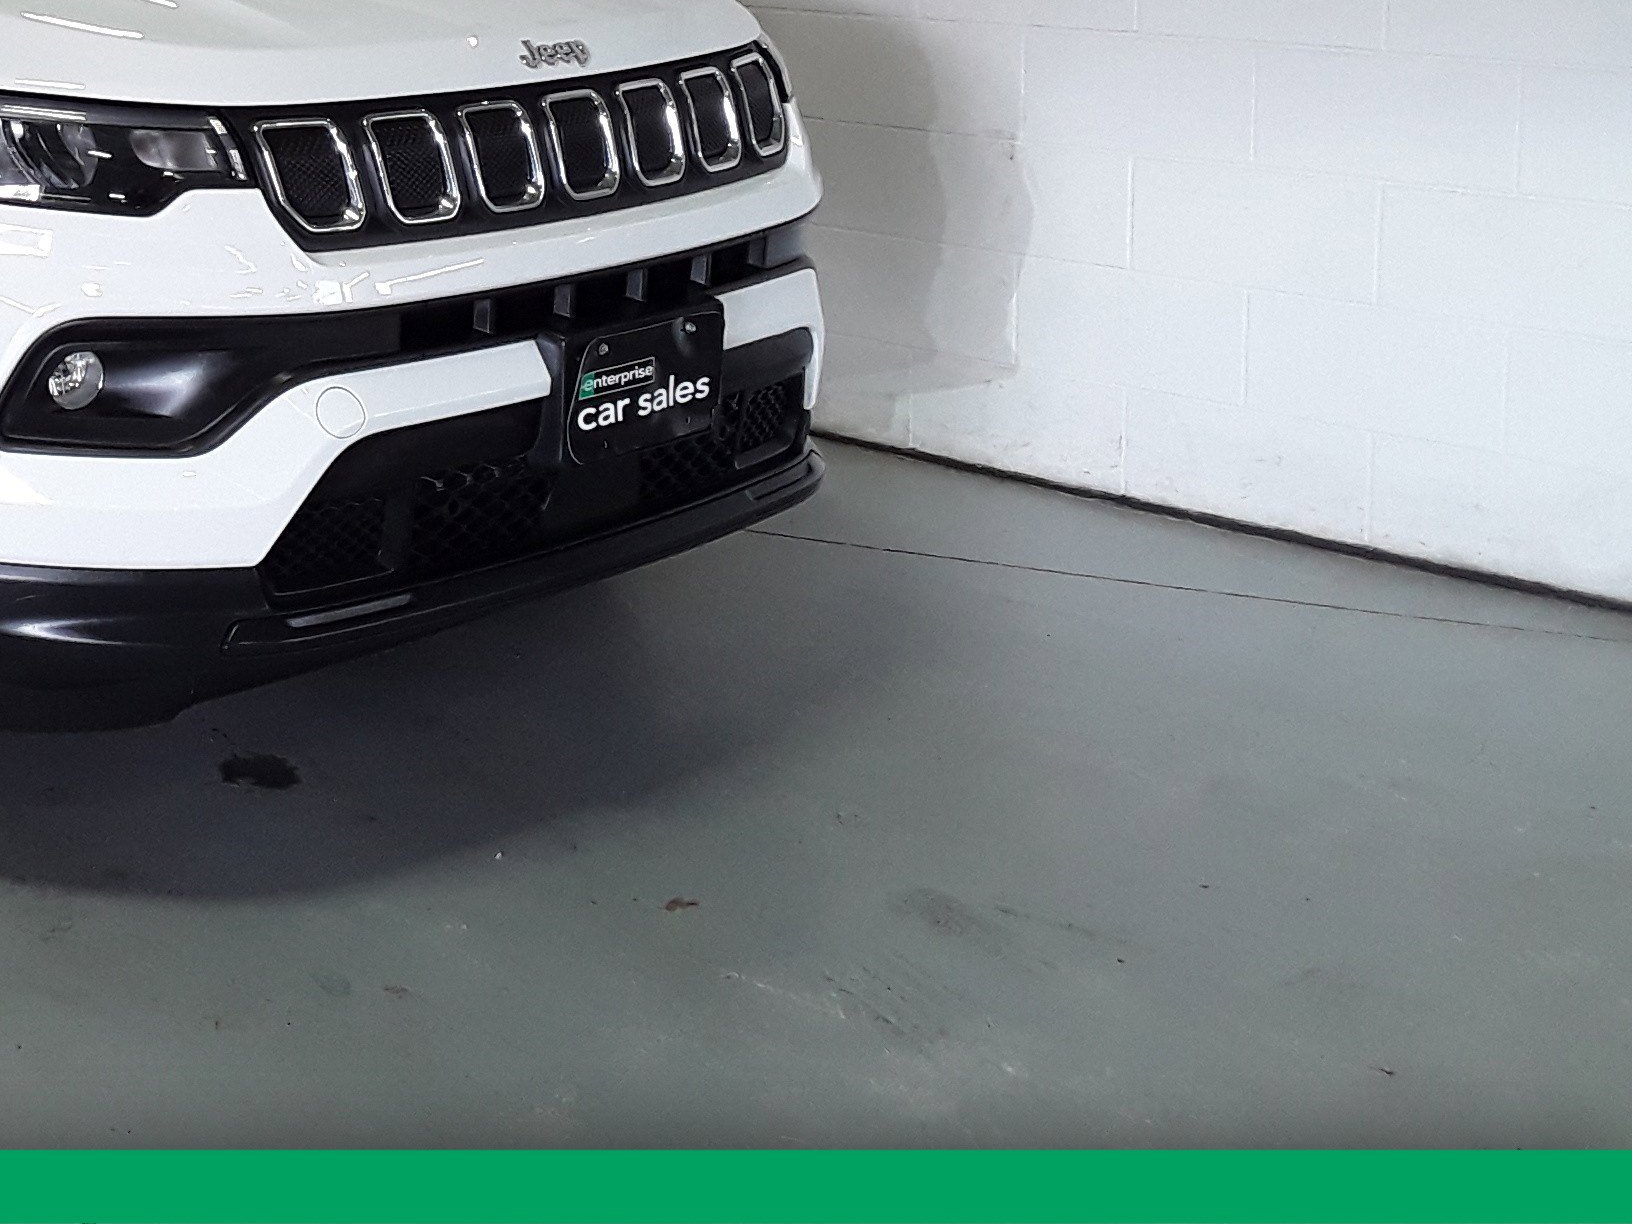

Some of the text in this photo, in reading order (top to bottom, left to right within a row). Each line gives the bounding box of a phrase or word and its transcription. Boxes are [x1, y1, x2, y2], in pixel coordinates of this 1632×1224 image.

[519, 39, 590, 68] Jeep
[581, 365, 655, 392] enterprise
[577, 374, 711, 431] car sales
